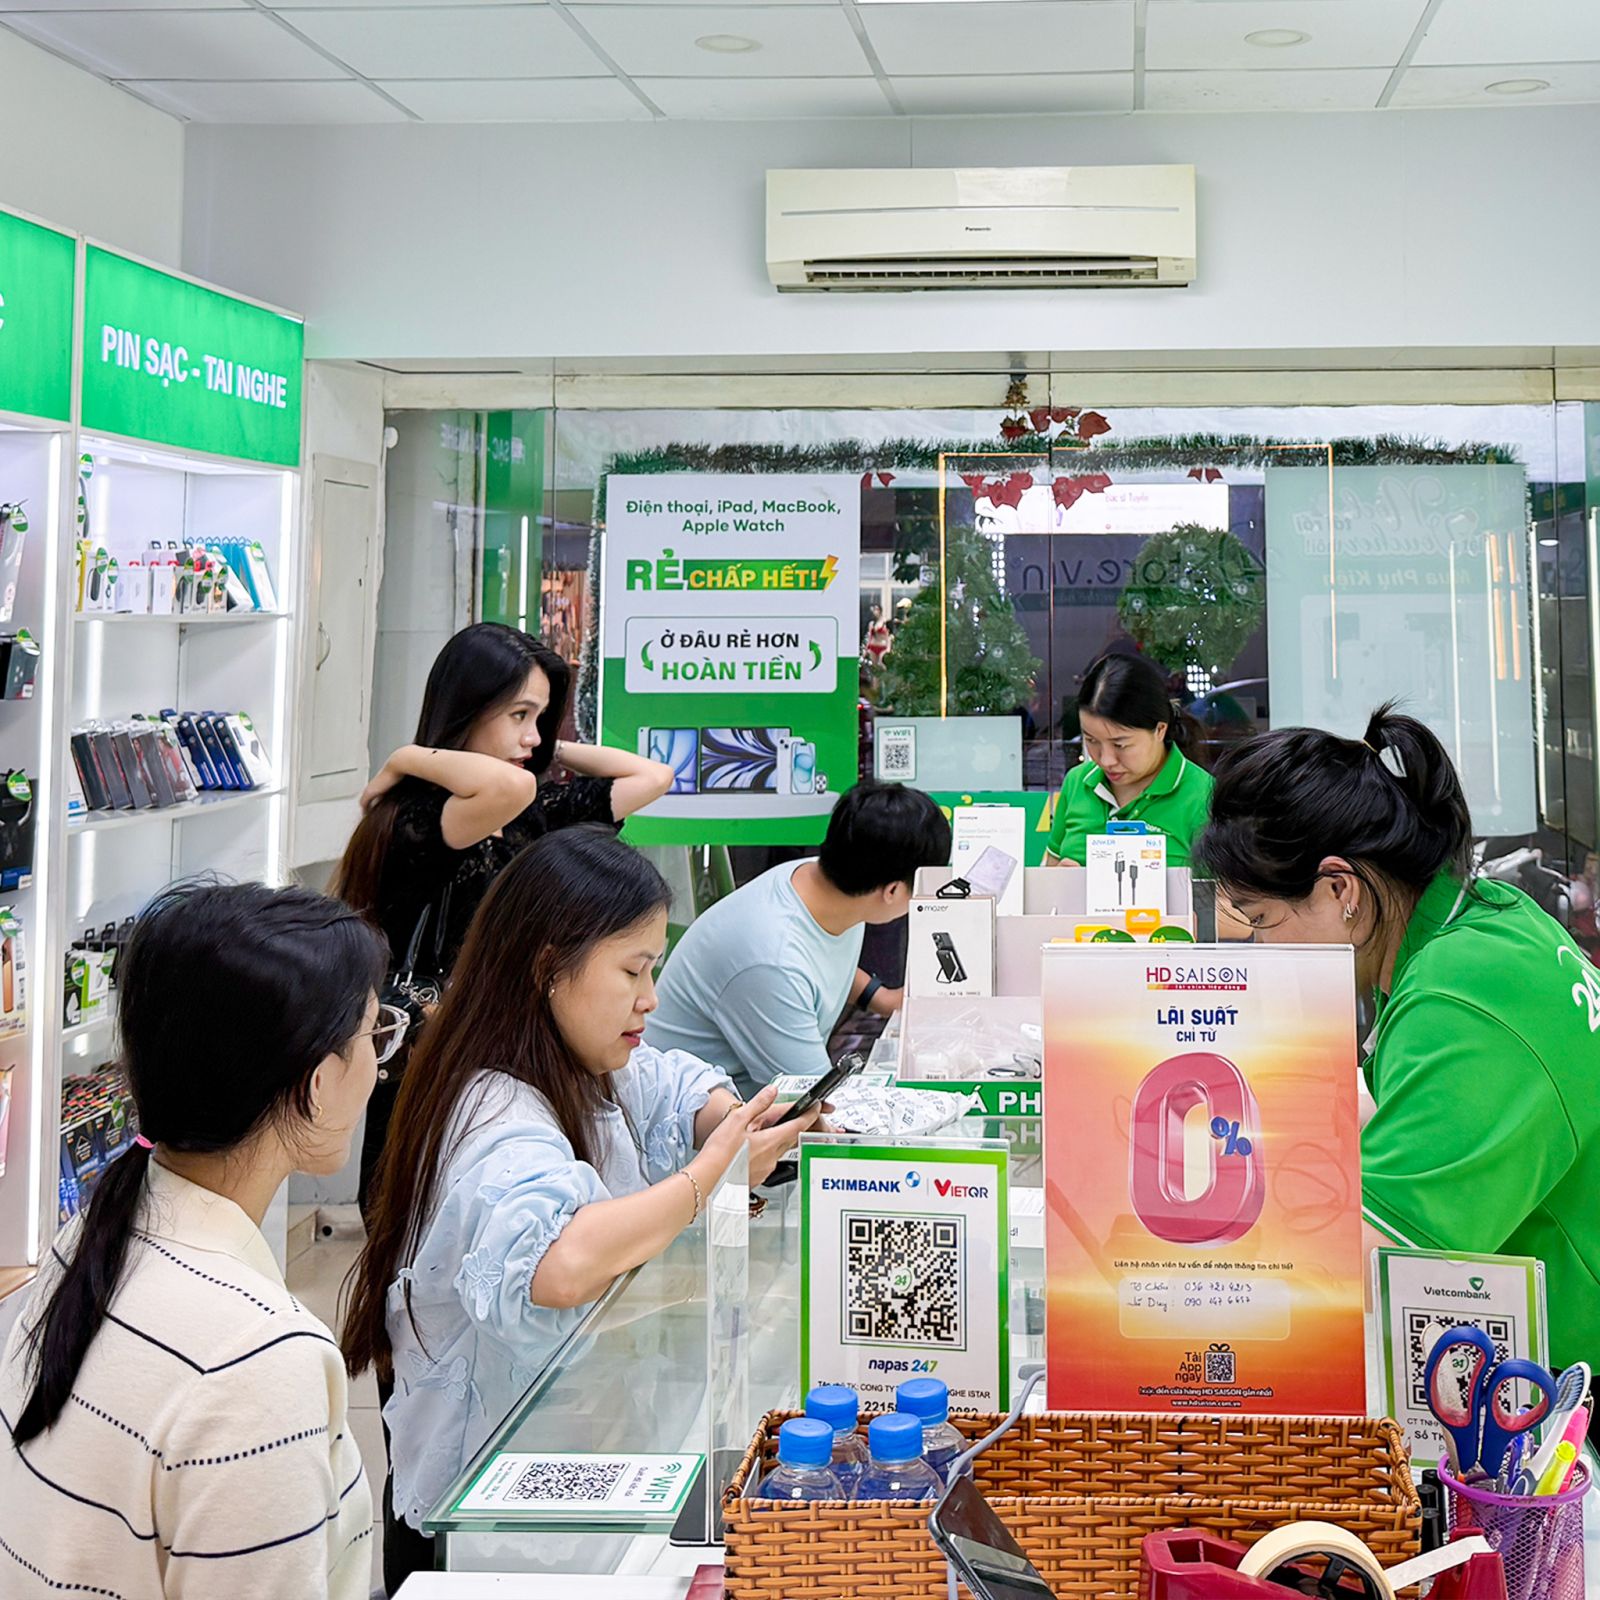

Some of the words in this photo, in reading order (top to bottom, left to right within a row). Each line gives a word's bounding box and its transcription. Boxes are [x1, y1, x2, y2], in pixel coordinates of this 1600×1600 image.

[102, 324, 141, 371] PIN
[144, 337, 189, 388] SẠC
[203, 354, 233, 395] TAI
[236, 364, 288, 409] NGHE
[626, 500, 663, 517] Điện
[667, 500, 713, 517] thoại,
[717, 500, 758, 515] iPad,
[762, 500, 842, 515] MacBook,
[682, 519, 730, 534] Apple
[734, 519, 785, 532] Watch
[626, 548, 684, 591] RẺ
[689, 563, 757, 588] CHẤP
[762, 563, 818, 588] HẾT!
[680, 629, 721, 648] ĐÂU
[726, 629, 751, 648] RẺ
[756, 632, 800, 648] HƠN
[661, 657, 737, 681] HOÀN
[742, 655, 803, 681] TIỀN
[1146, 967, 1172, 982] HD
[1175, 967, 1248, 983] SAISON
[1157, 1005, 1184, 1025] LÃI
[1191, 1004, 1239, 1026] SUẤT
[1200, 1027, 1217, 1042] TỪ
[999, 1091, 1041, 1114] PH
[822, 1178, 900, 1193] EXIMBANK
[1423, 1286, 1492, 1300] Vietcombank
[1185, 1351, 1202, 1363] Tải
[868, 1359, 908, 1373] napas
[911, 1359, 938, 1373] 247
[1179, 1362, 1202, 1374] App
[1174, 1372, 1202, 1383] ngay
[968, 1391, 991, 1399] ISTAR
[1414, 1430, 1429, 1440] Số
[639, 1475, 677, 1504] WIFI
